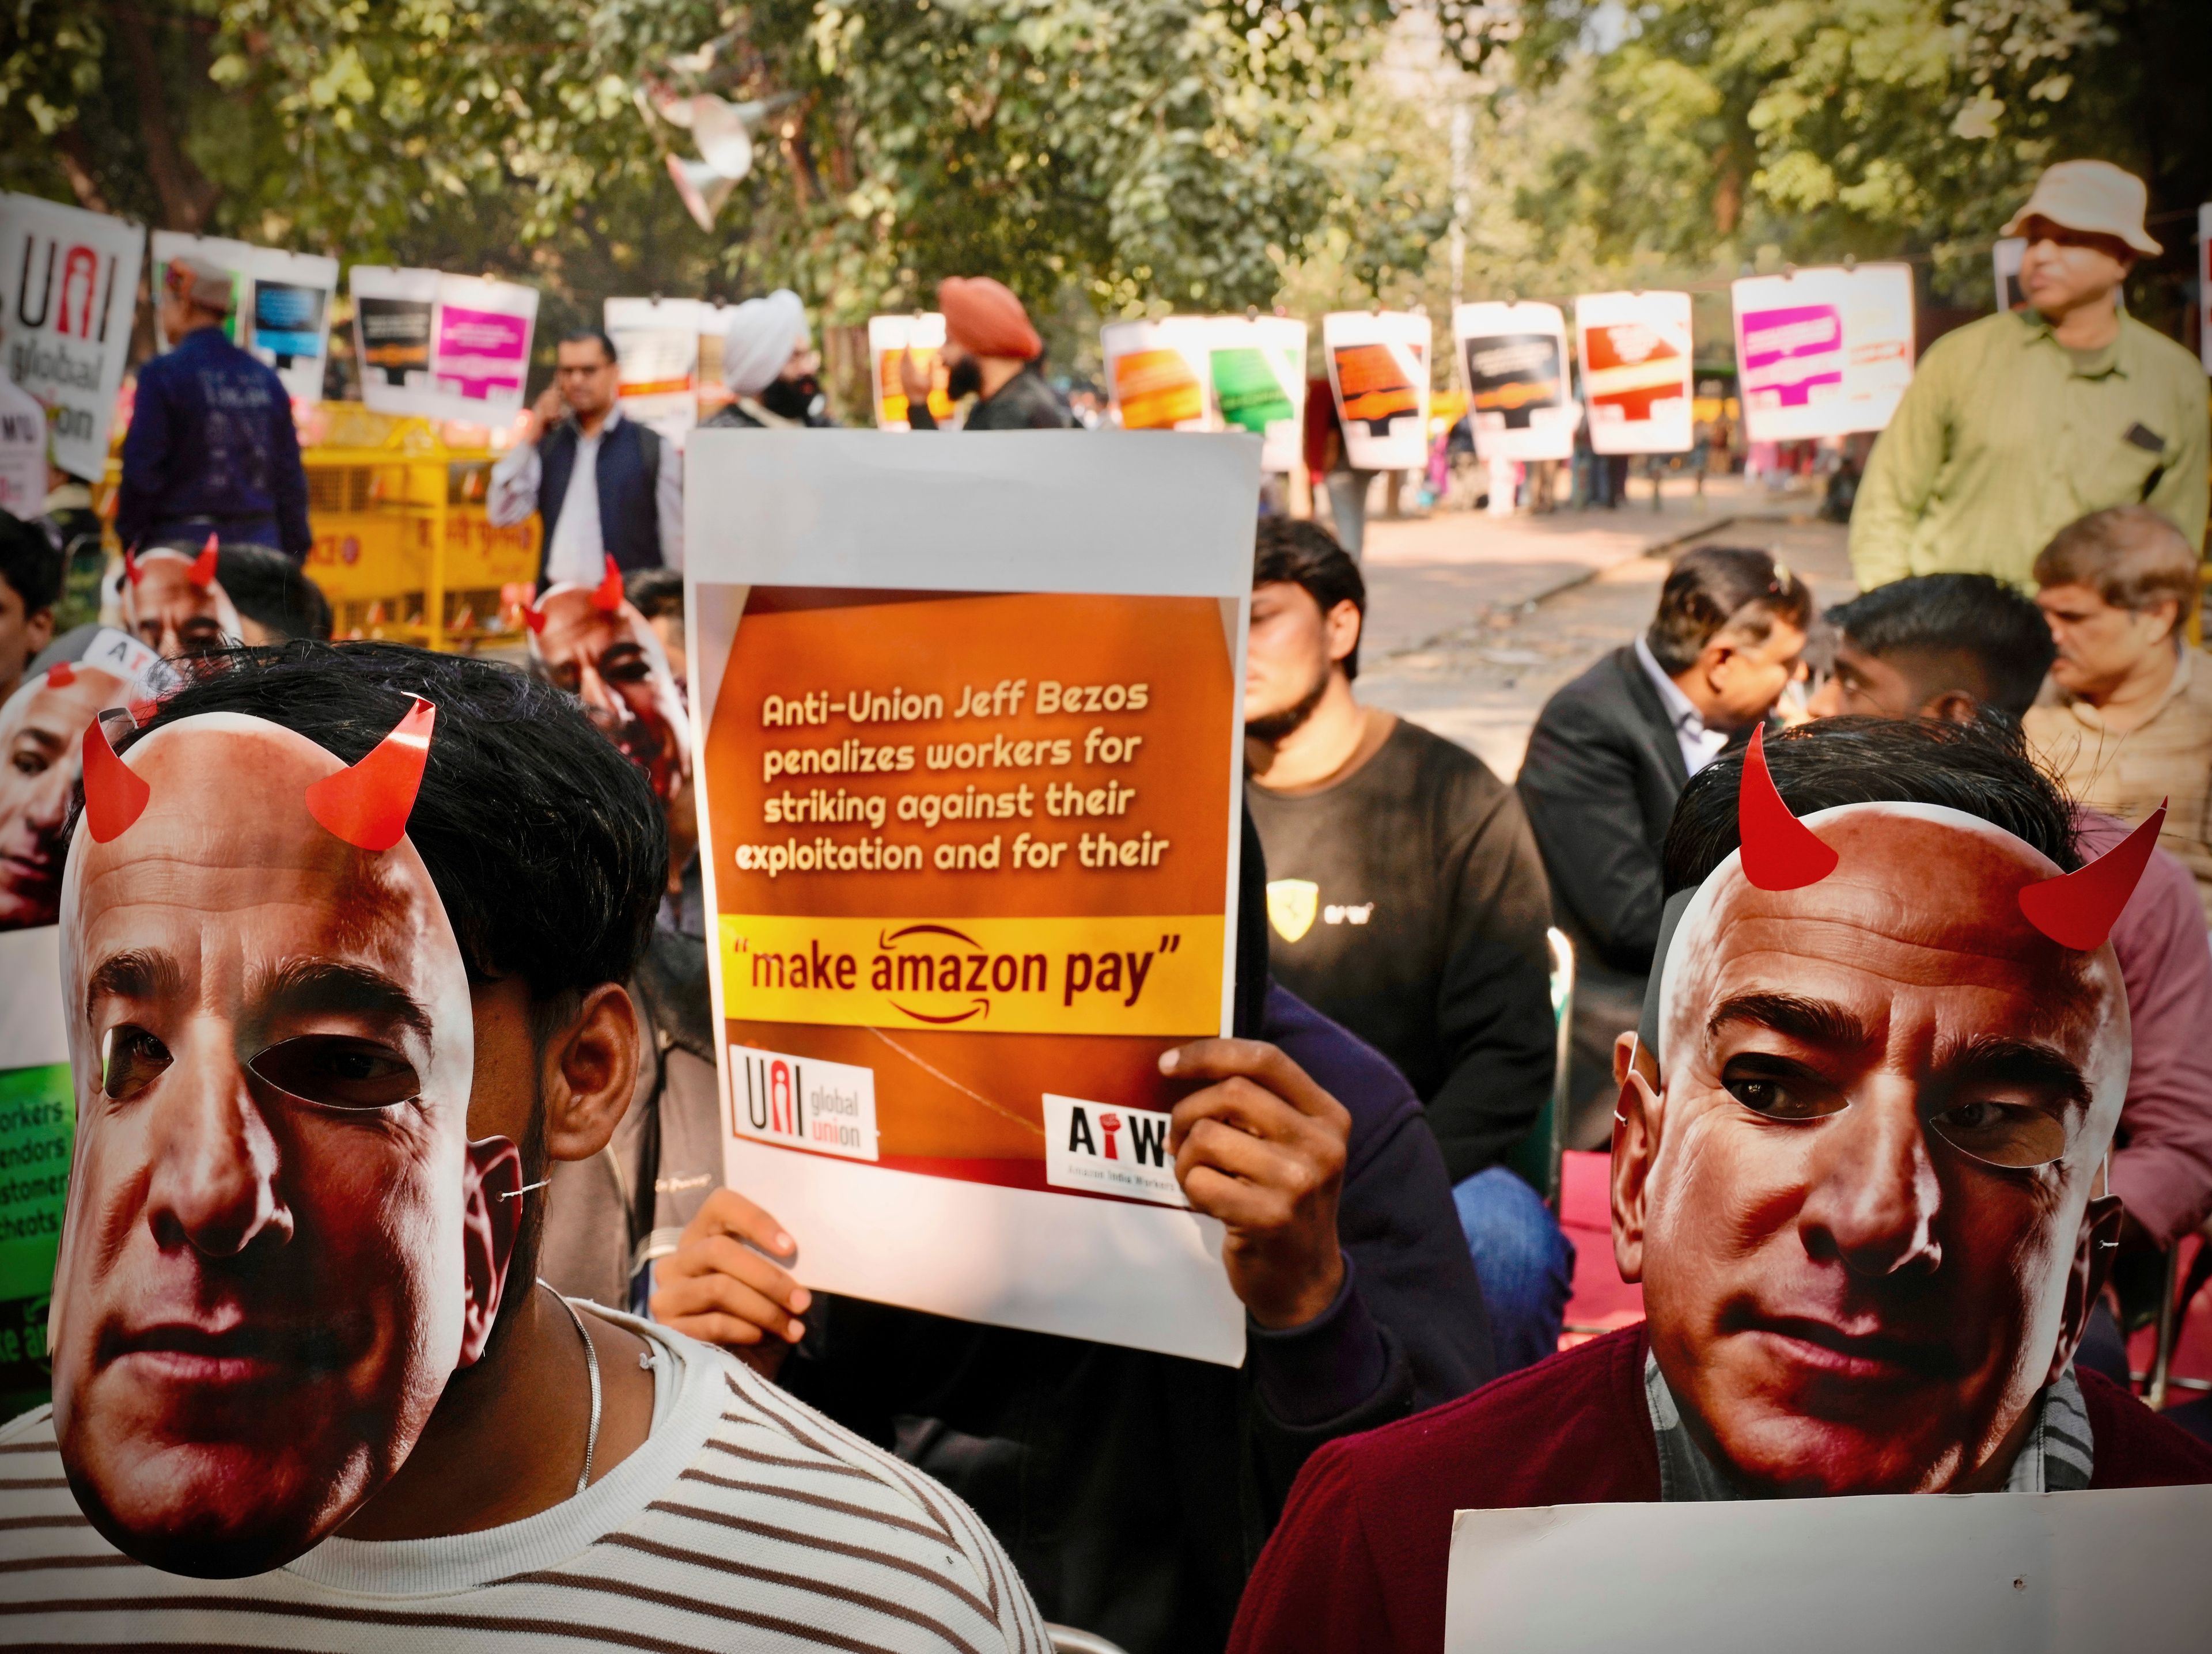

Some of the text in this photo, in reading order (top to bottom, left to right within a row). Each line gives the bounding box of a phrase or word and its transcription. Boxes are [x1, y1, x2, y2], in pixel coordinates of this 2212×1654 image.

[763, 680, 1149, 726] Anti-Union Jeff Bezos
[764, 727, 1142, 782] penalizes workers for
[764, 780, 1135, 829] striking against their
[735, 832, 1169, 877] exploitation and for their
[735, 934, 1180, 1007] “make amazon pay”
[0, 1101, 63, 1133] orkers
[811, 1085, 858, 1117] global
[813, 1117, 861, 1148] union
[0, 1136, 66, 1170] endors
[0, 1173, 69, 1205] stomer
[1069, 1166, 1175, 1190] Amazon India Workers
